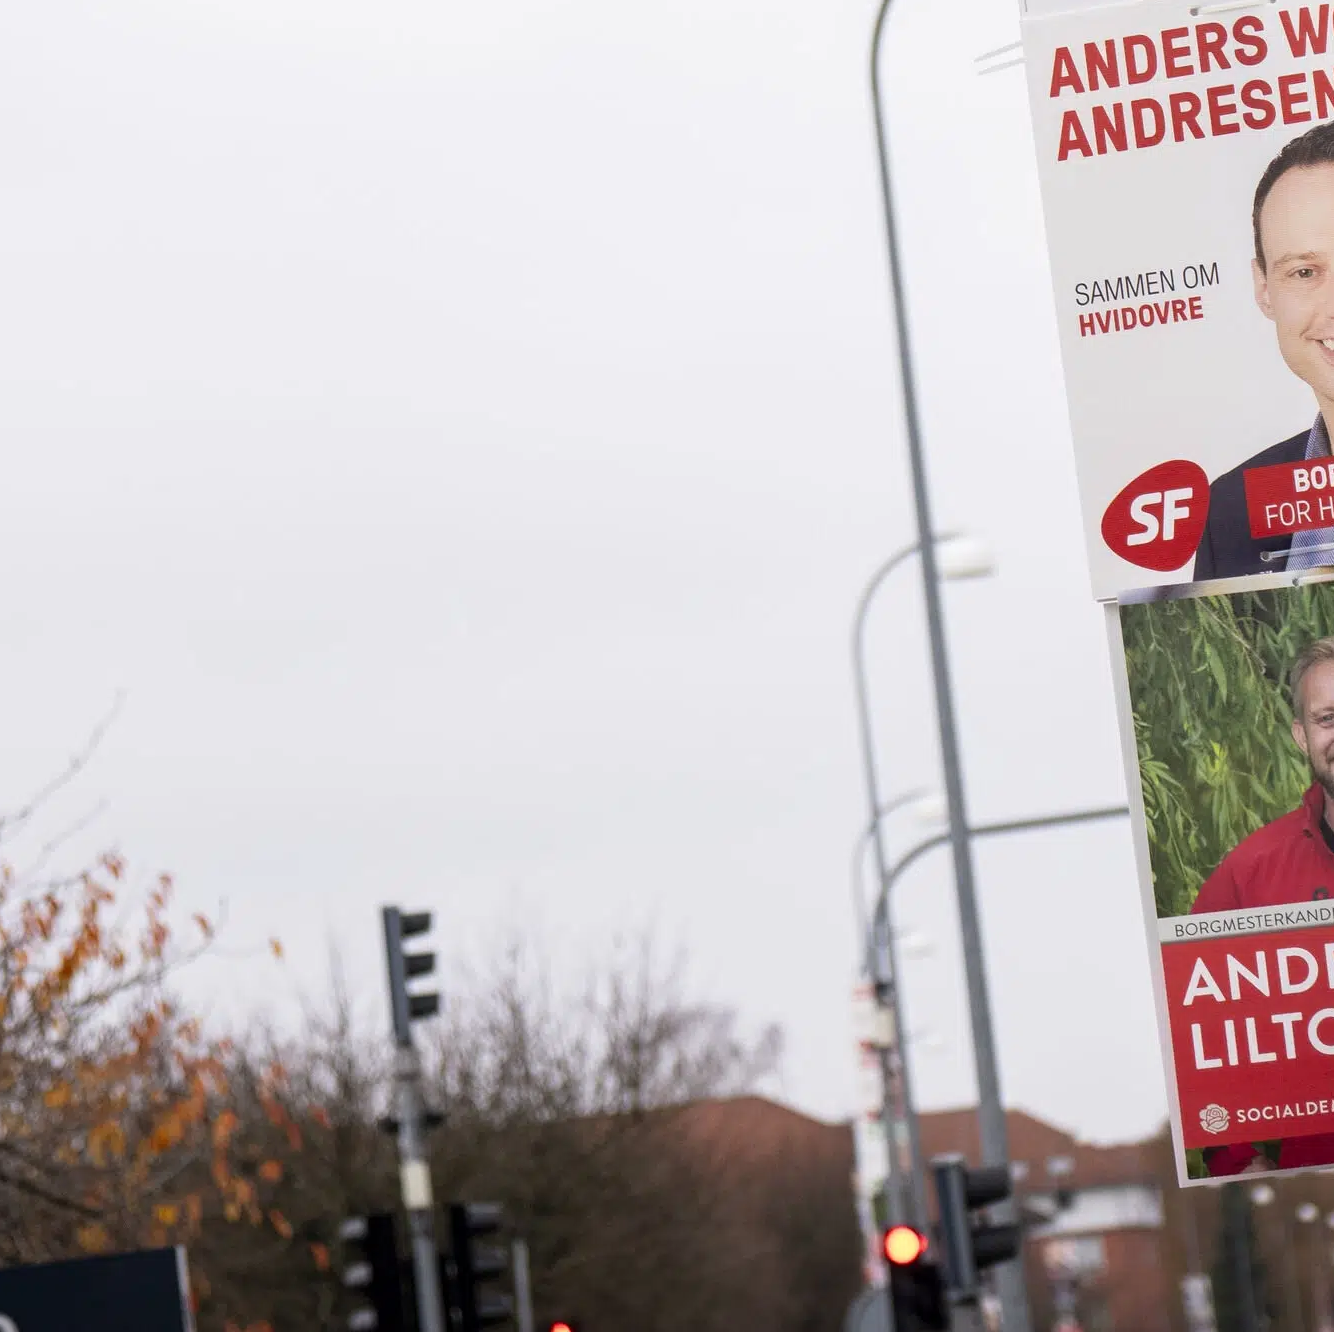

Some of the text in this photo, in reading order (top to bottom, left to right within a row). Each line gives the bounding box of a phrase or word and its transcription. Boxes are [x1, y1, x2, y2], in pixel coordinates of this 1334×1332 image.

[1049, 15, 1268, 98] ANDERS
[1075, 262, 1220, 306] SAMMEN OM
[1079, 296, 1204, 337] HVIDOVRE
[1127, 487, 1194, 546] SF
[1265, 500, 1312, 529] FOR
